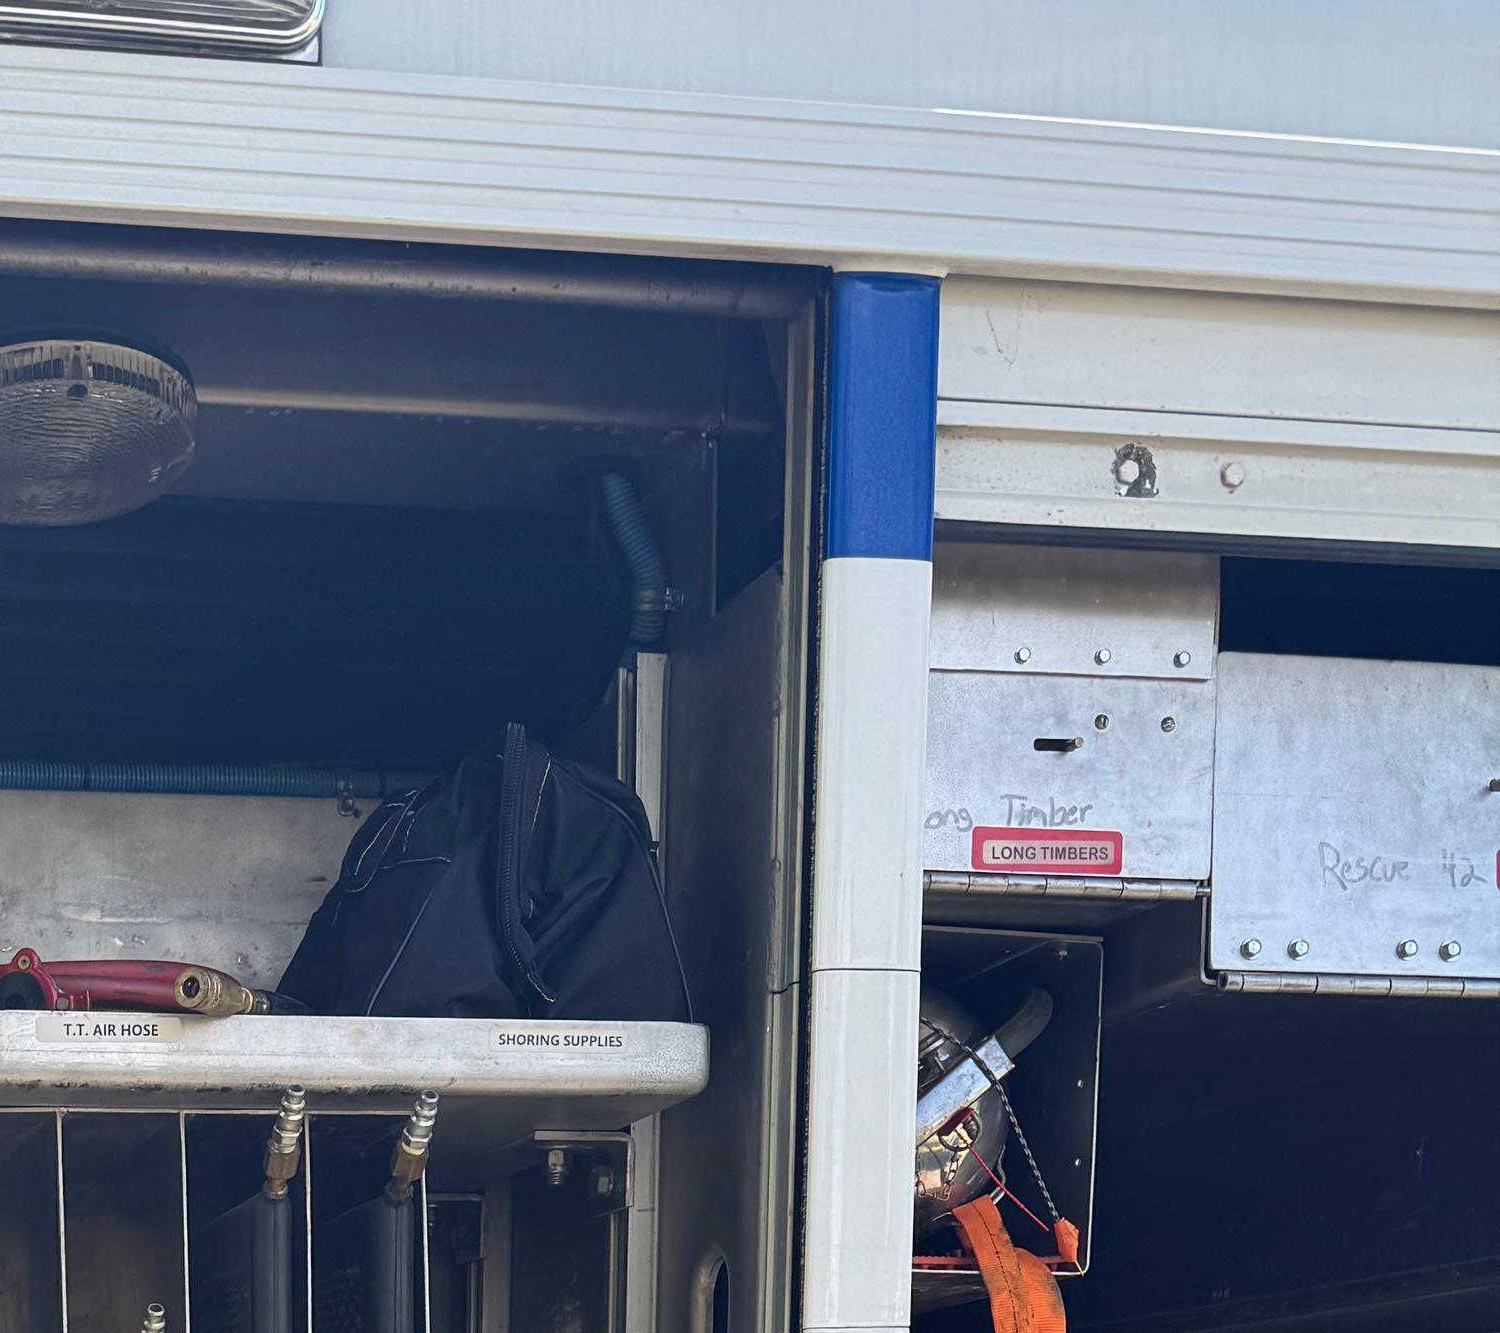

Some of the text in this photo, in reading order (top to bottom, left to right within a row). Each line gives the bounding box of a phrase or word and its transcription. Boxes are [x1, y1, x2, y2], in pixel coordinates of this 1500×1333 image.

[924, 793, 1093, 833] ong Timber
[992, 846, 1109, 861] LONG TIMBERS
[1318, 842, 1410, 891] Rescue
[63, 1023, 159, 1037] T.T. AIR HOSE
[498, 1033, 623, 1047] SHORING SUPPLIES
